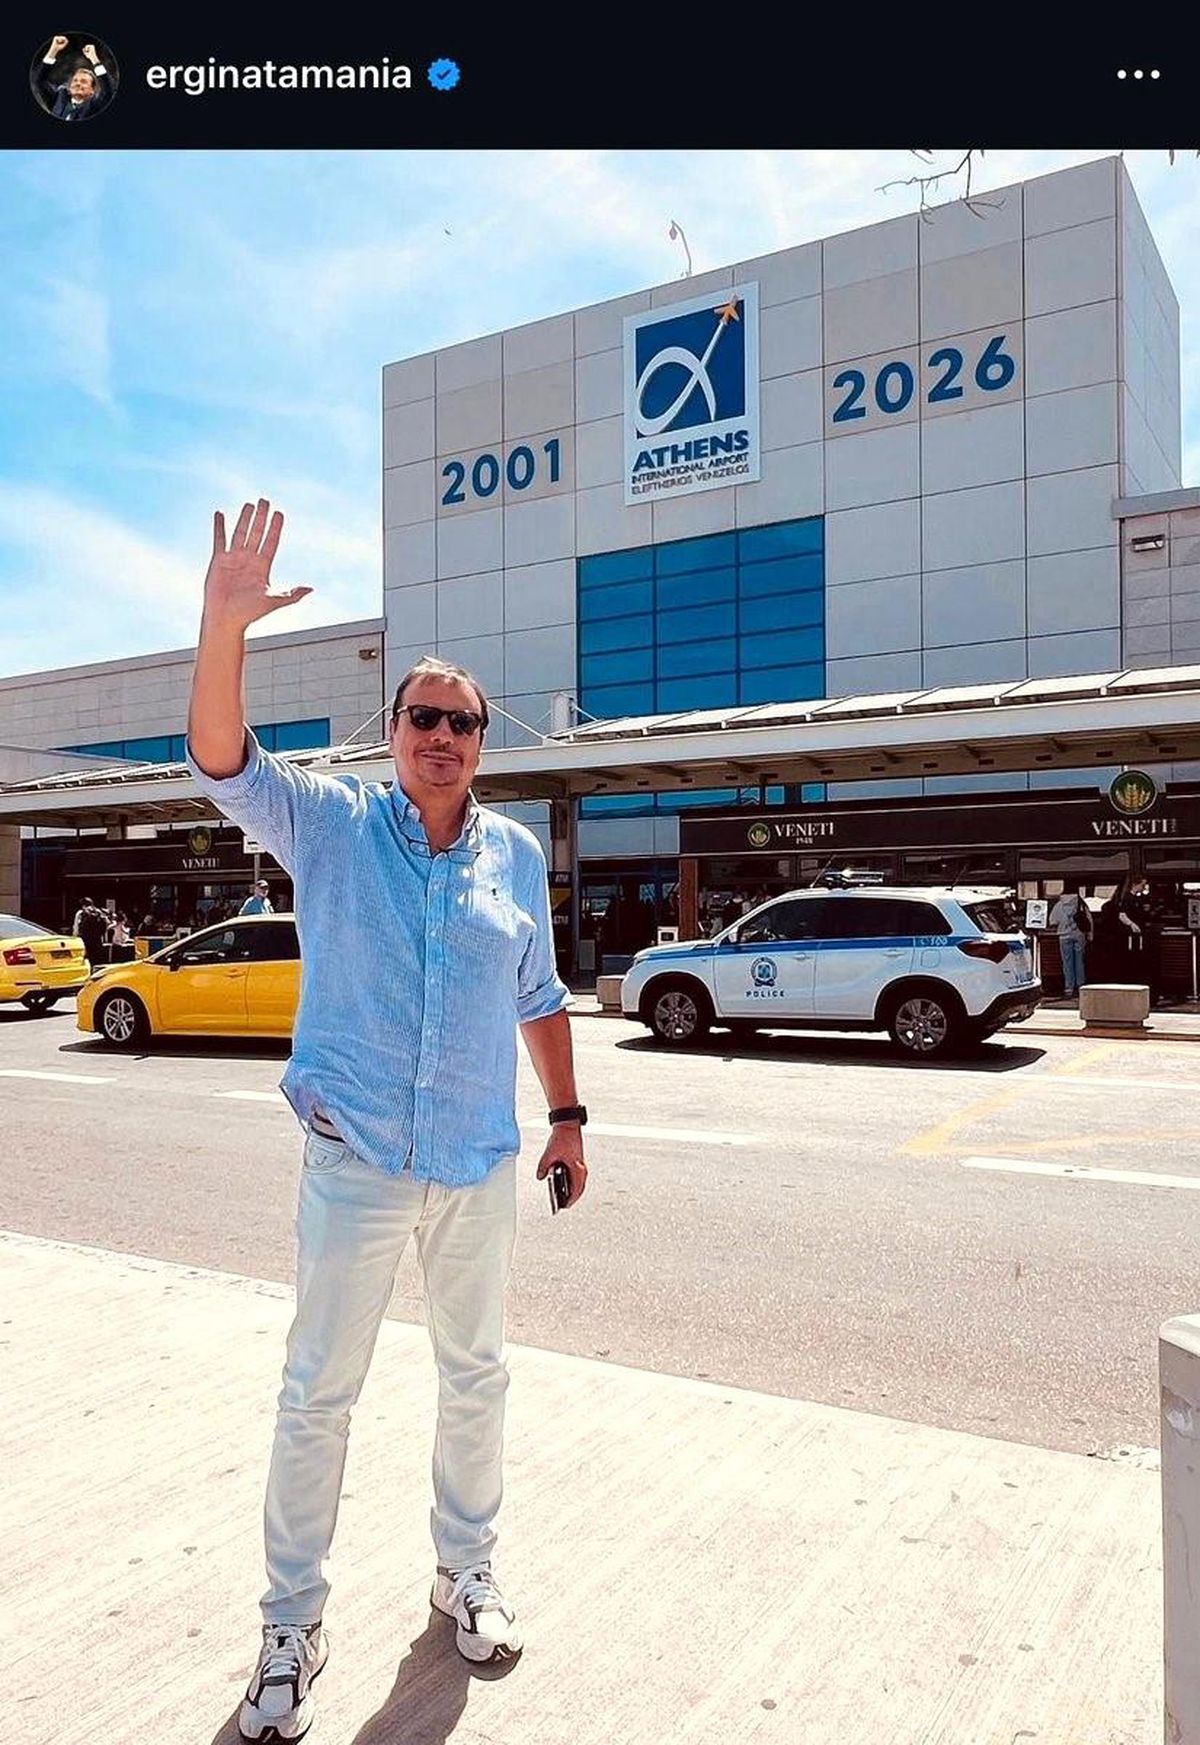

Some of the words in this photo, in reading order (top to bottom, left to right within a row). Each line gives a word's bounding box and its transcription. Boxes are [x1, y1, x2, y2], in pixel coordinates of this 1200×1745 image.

[832, 335, 1016, 423] 2026
[632, 429, 749, 473] ATHENS
[441, 438, 560, 506] 2001
[631, 462, 705, 484] INTERNATIONAL
[708, 452, 749, 469] AIRPORT
[631, 475, 693, 495] ELEFTHERIOS
[695, 463, 750, 481] VENIZELOS
[774, 821, 834, 837] VENETI
[1092, 818, 1168, 835] VENETI
[745, 990, 785, 998] POLICE
